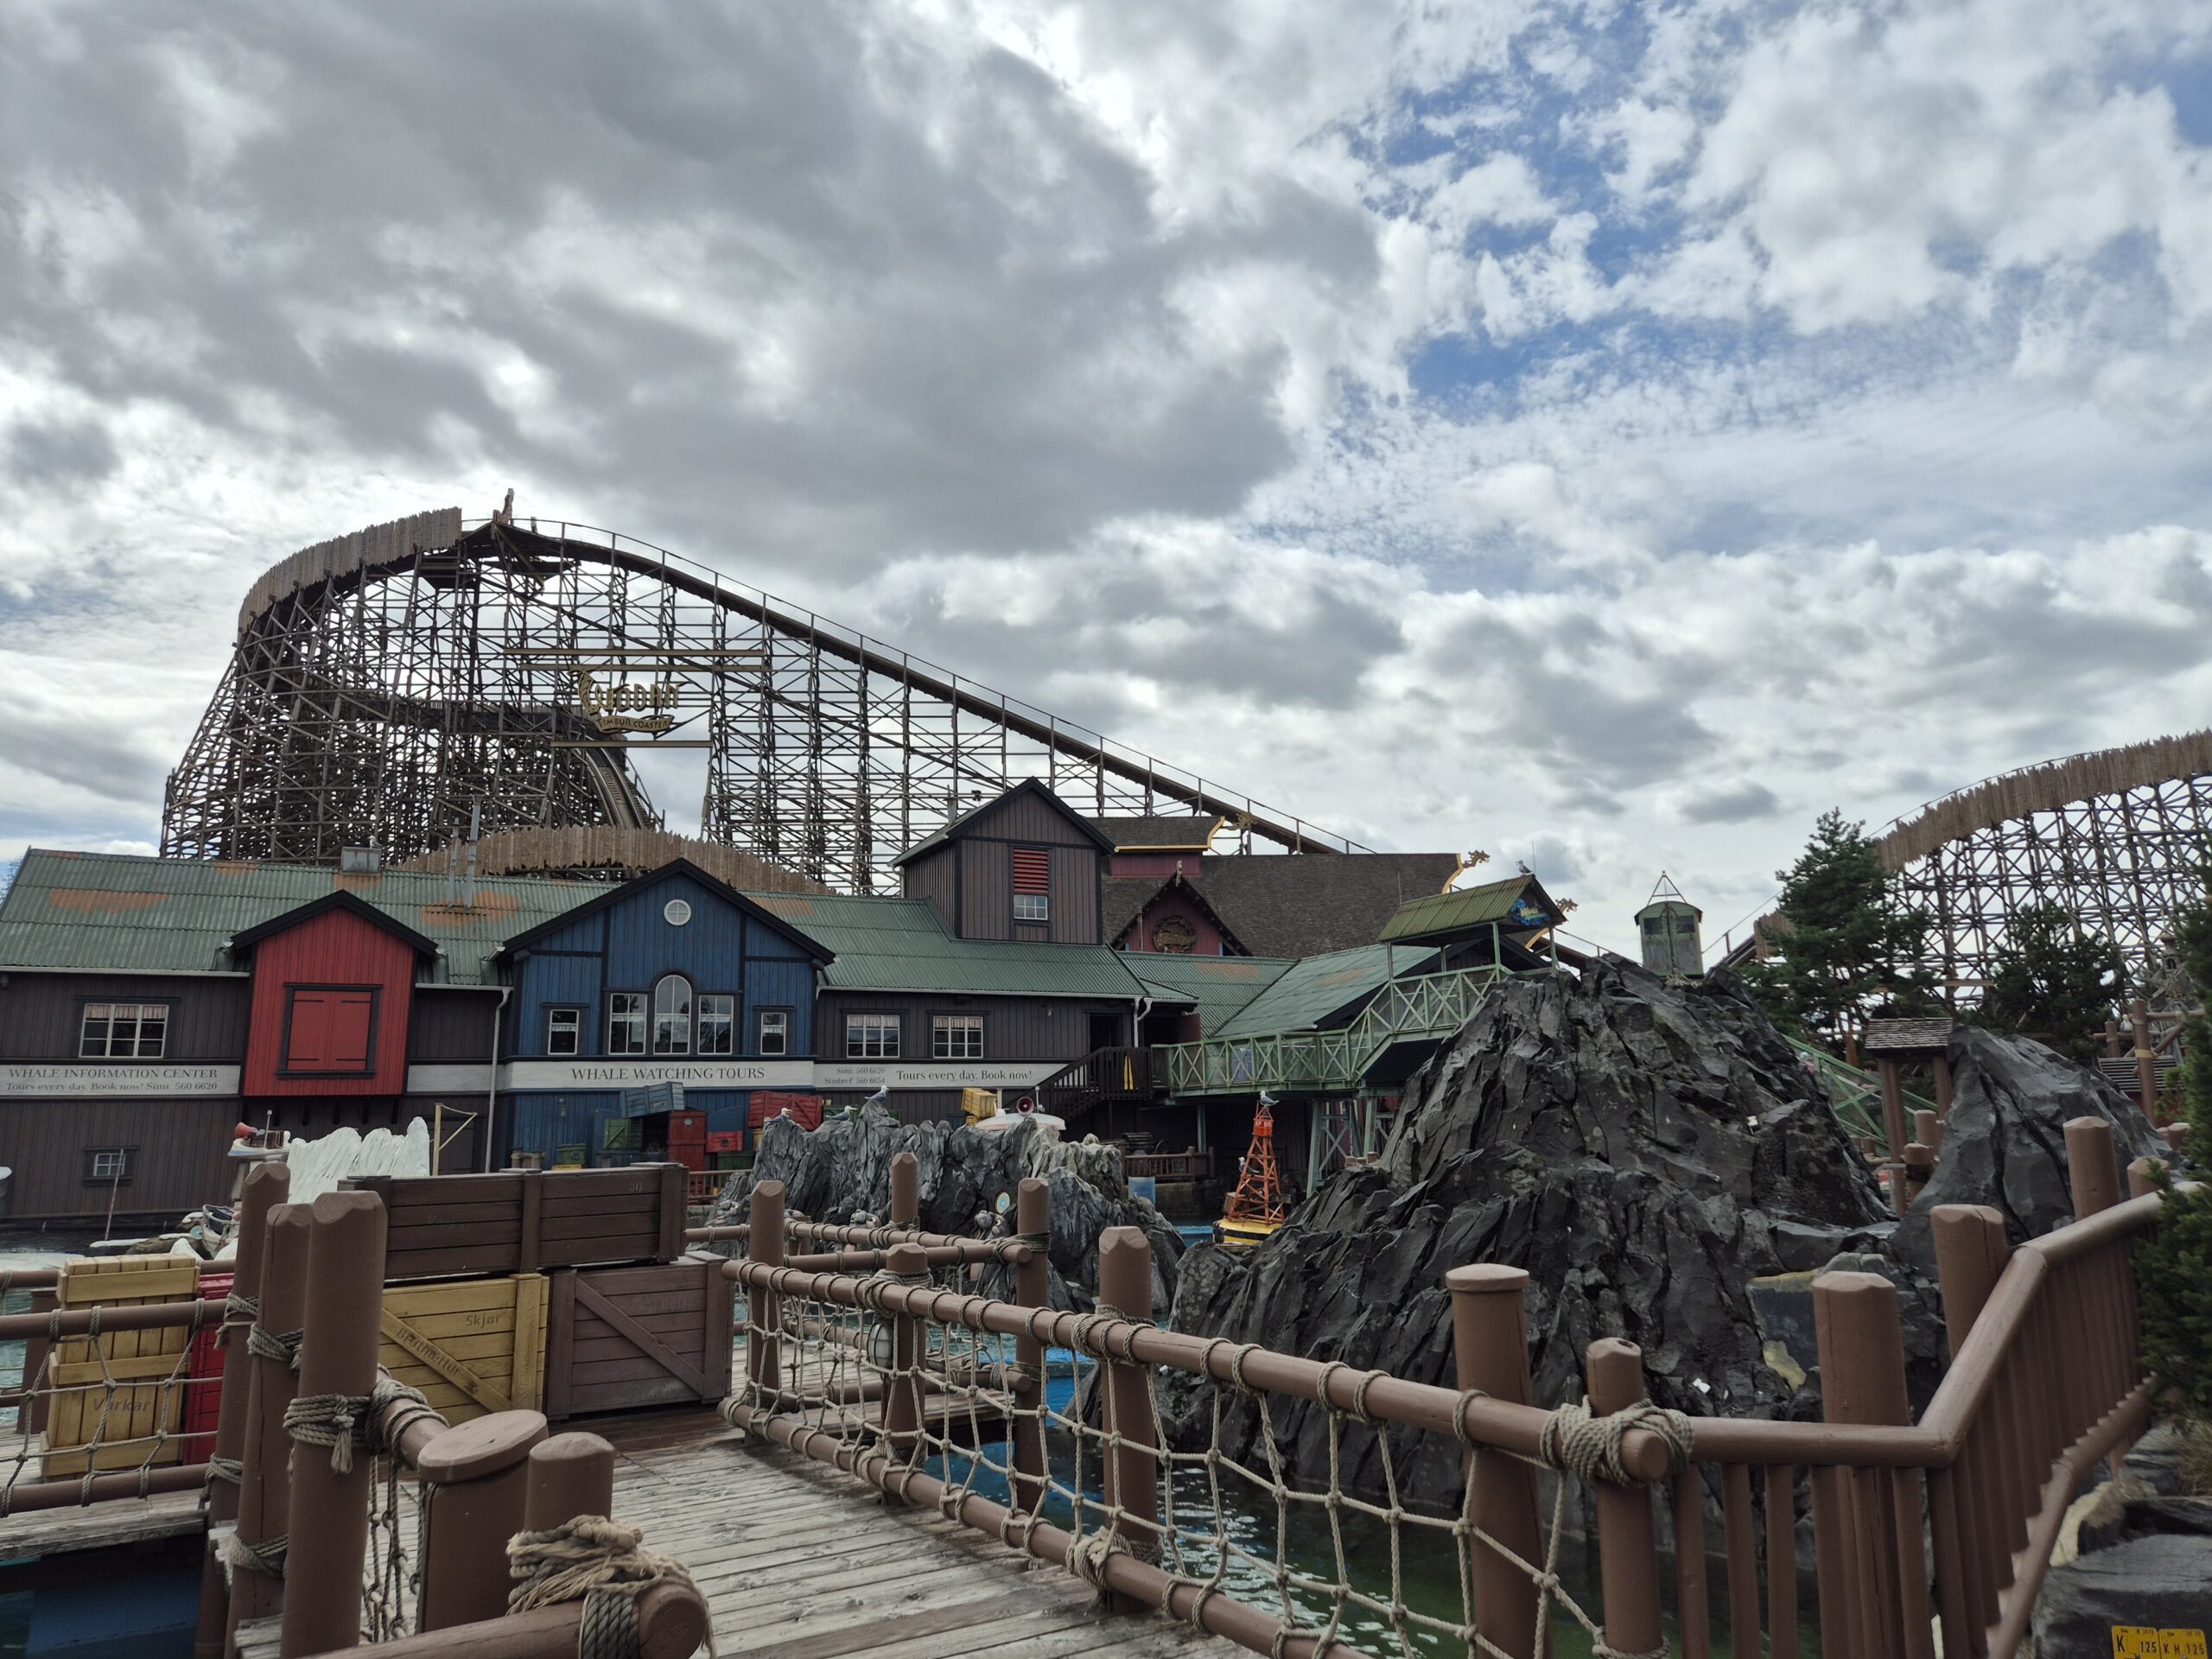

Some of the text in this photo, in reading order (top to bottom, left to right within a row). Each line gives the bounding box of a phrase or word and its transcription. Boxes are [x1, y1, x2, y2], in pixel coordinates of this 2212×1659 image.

[596, 719, 667, 729] TIMBUR COASTER
[10, 1068, 218, 1078] WHALE INFORMATION CENTER
[571, 1068, 765, 1080] WHALE WATCHING TOURS
[896, 1070, 1032, 1082] Tours every day. Book now!
[7, 1082, 35, 1091] Tours
[38, 1084, 66, 1092] every
[91, 1082, 118, 1090] Book
[175, 1082, 193, 1090] 560
[194, 1082, 218, 1090] 6620
[2116, 1635, 2157, 1653] K 125
[2186, 1643, 2204, 1656] 125
